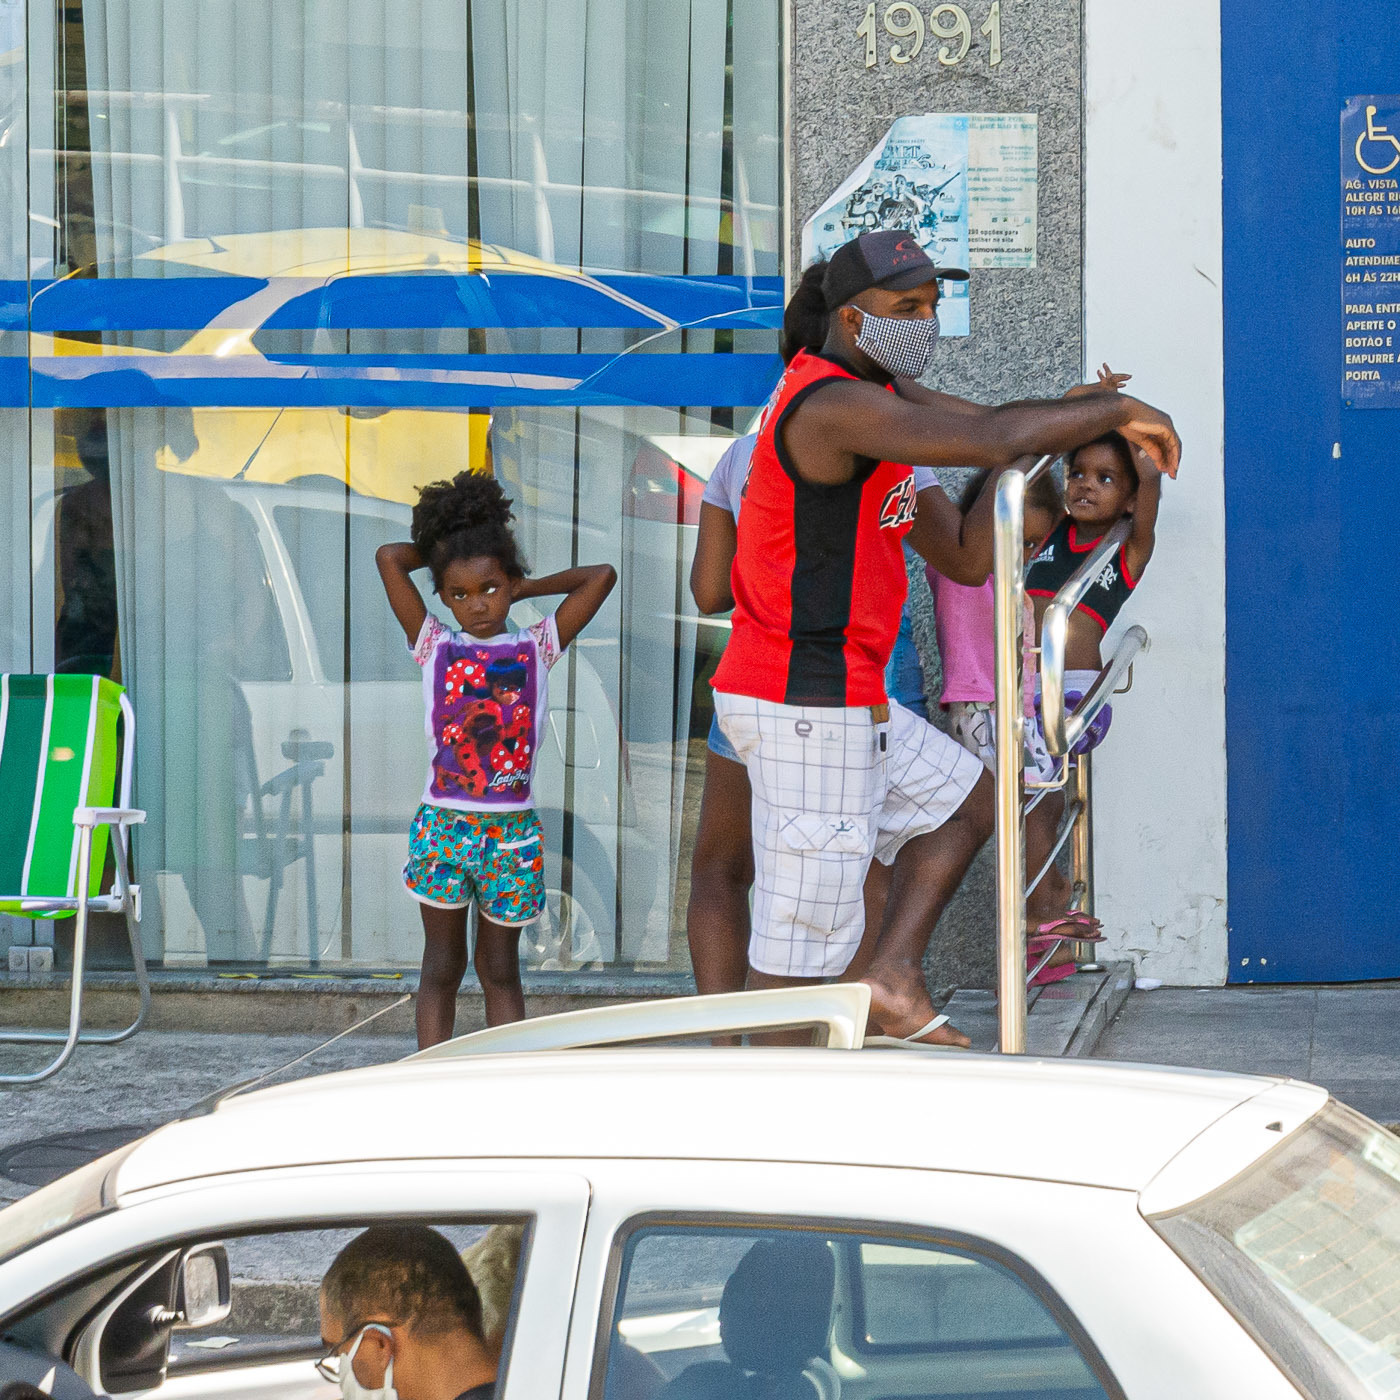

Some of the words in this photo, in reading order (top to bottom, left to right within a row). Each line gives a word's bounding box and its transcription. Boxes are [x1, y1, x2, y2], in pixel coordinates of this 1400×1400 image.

[856, 1, 1002, 68] 1991
[1368, 180, 1398, 189] VISTA
[1345, 192, 1385, 202] ALEGRE
[1345, 206, 1366, 215] 10H
[1345, 238, 1375, 248] AUTO
[1345, 273, 1360, 282] 6H
[1380, 272, 1400, 282] 22H
[1345, 304, 1373, 314] PARA
[1346, 320, 1384, 330] APERTE
[1387, 320, 1396, 330] O
[1386, 337, 1392, 347] E
[1345, 354, 1394, 364] EMPURRE
[1345, 371, 1380, 380] PORTA
